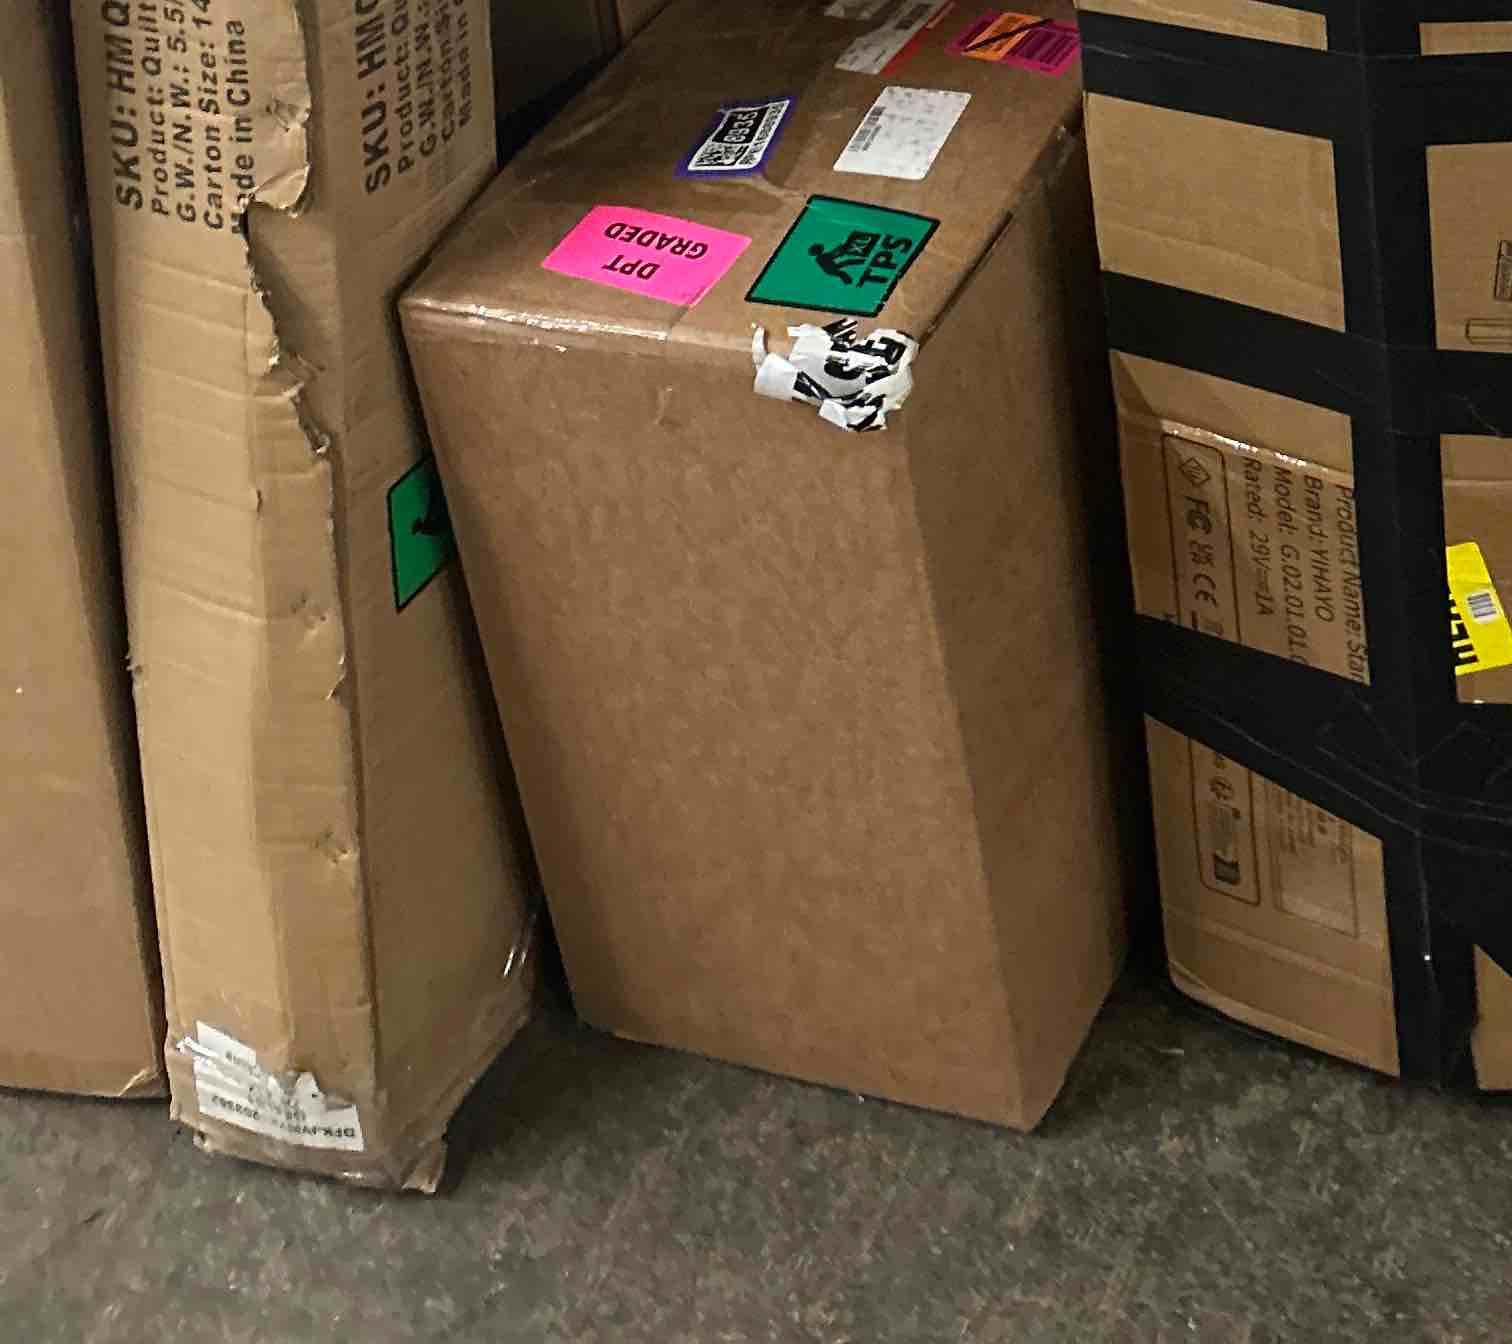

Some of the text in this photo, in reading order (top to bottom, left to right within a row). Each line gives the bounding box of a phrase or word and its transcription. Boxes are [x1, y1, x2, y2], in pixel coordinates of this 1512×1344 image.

[197, 41, 221, 115] Size:
[223, 19, 253, 144] in China
[109, 104, 144, 211] SKU:
[144, 86, 170, 216] Product:
[202, 124, 225, 231] Carton
[360, 82, 392, 194] SKU:
[600, 254, 661, 281] DPT
[603, 222, 710, 261] GRADED
[855, 233, 913, 289] TPS
[1241, 455, 1266, 522] Rated:
[1272, 464, 1297, 536] Model:
[1302, 474, 1335, 623] Brand: YIHAYO
